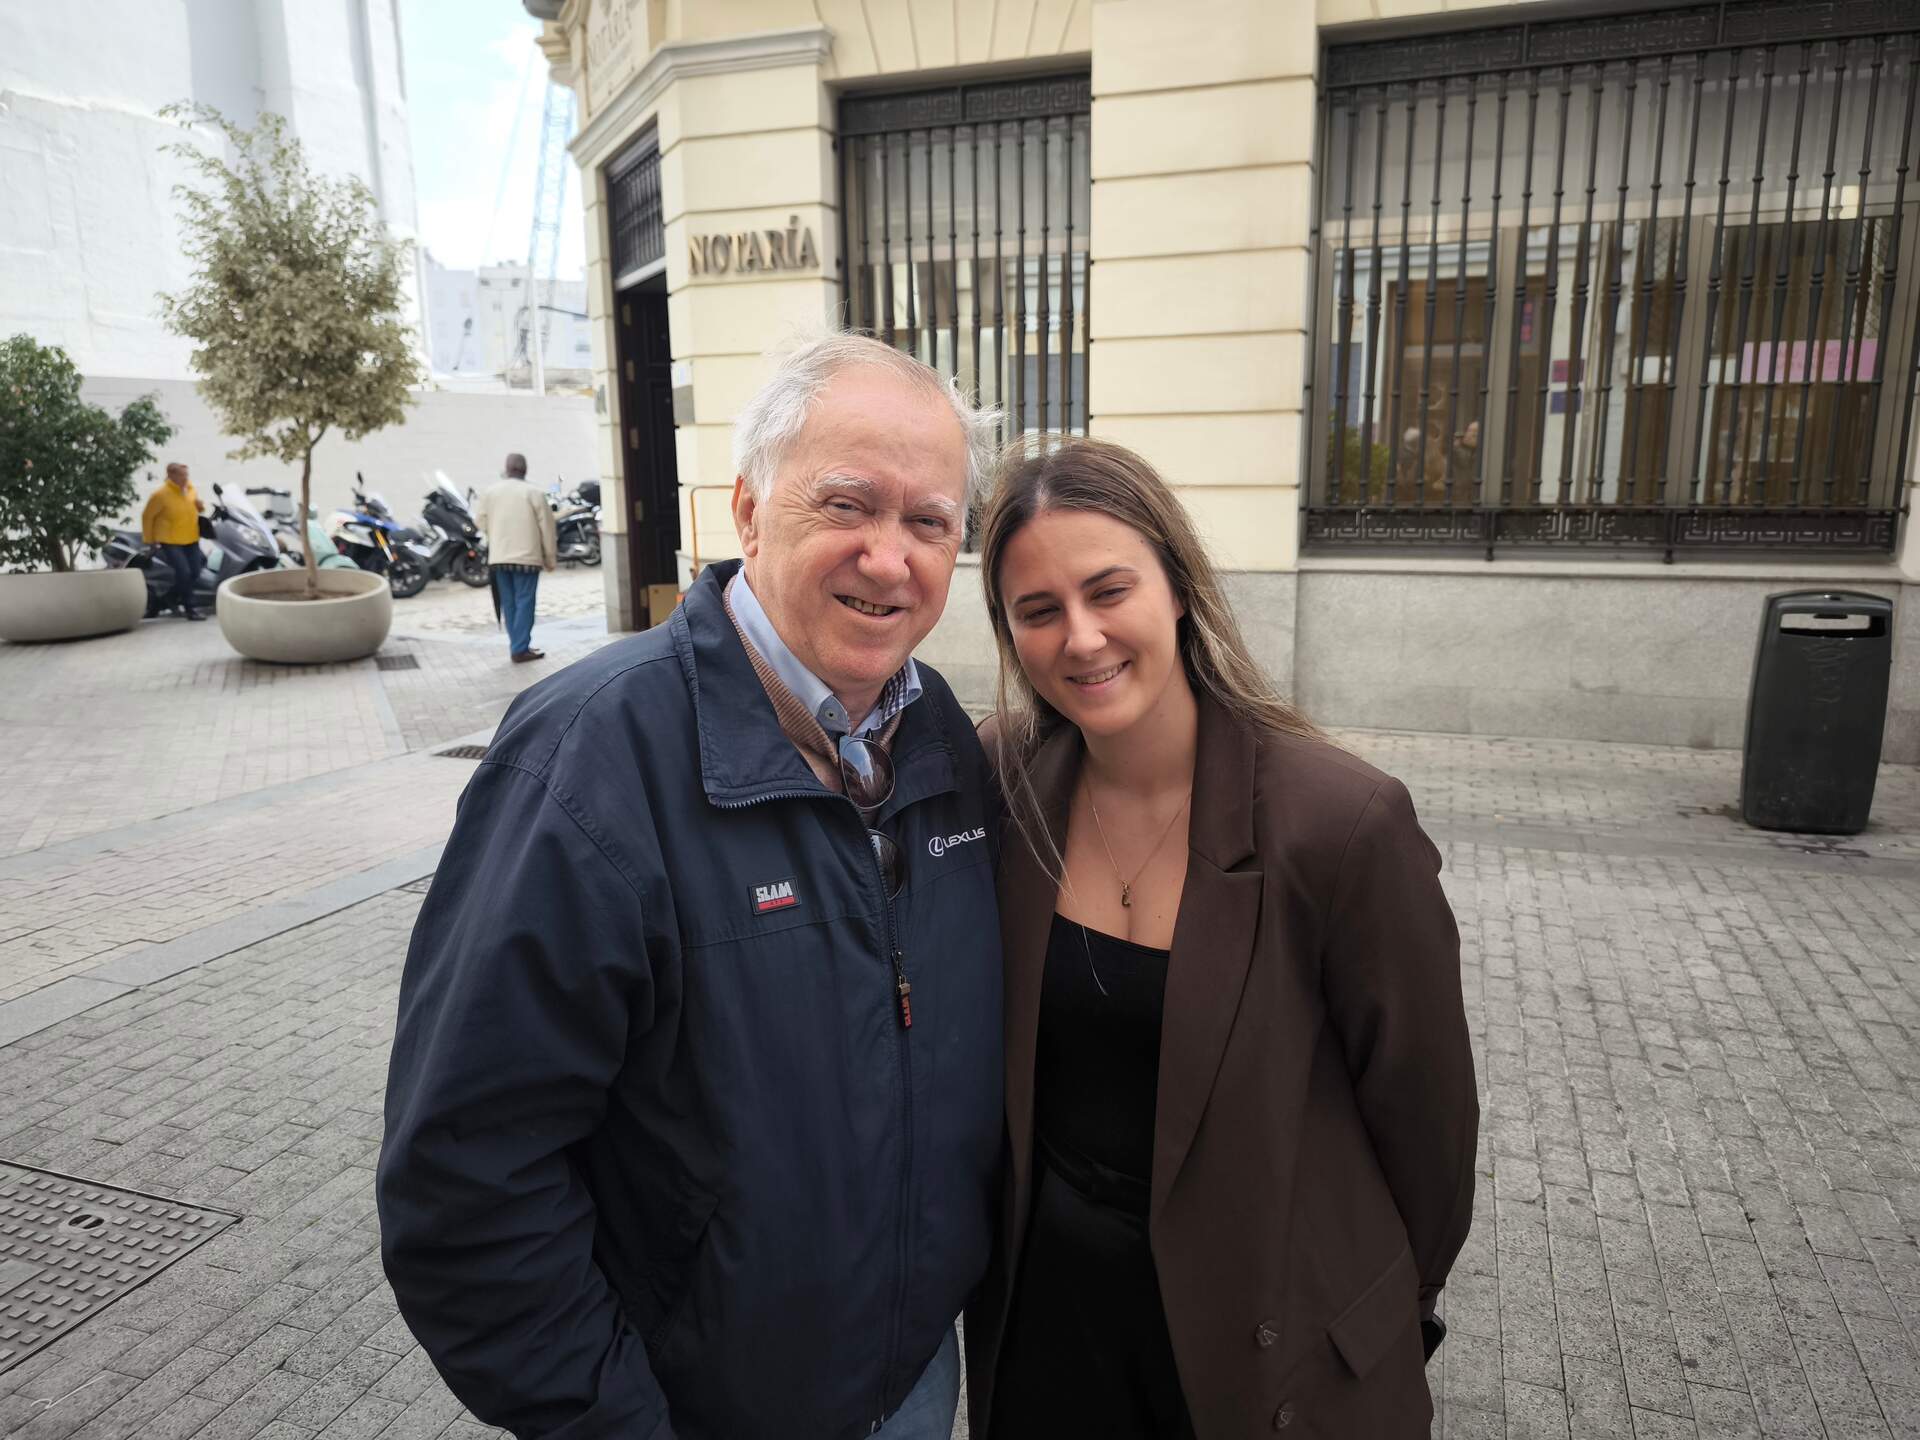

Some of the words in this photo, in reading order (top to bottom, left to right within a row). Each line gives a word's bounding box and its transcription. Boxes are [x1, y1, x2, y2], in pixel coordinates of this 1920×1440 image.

[688, 215, 820, 275] NOTARÍA
[942, 827, 986, 848] LEXUS
[755, 881, 793, 903] SLAM
